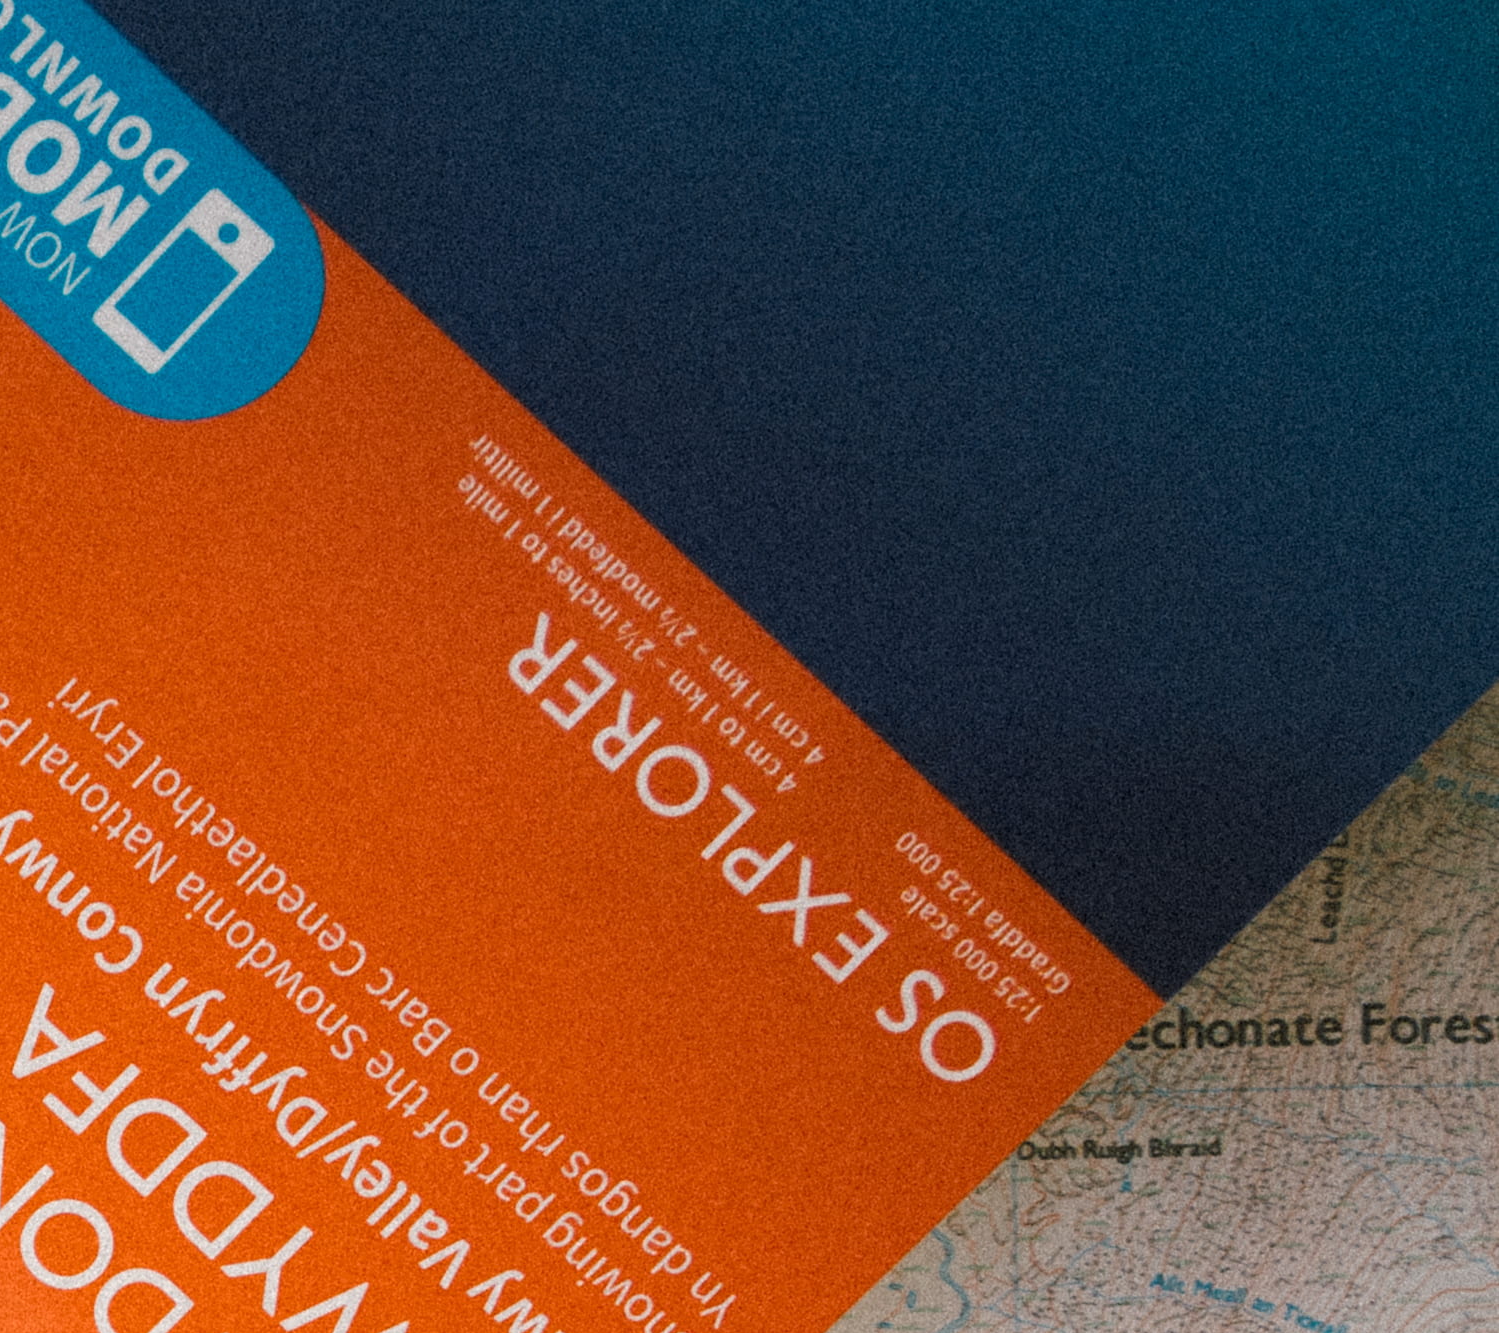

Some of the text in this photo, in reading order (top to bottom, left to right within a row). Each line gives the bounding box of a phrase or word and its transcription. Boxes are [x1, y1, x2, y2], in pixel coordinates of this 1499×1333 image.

[60, 759, 177, 881] National
[507, 611, 997, 1084] OS EXPLORER
[46, 677, 740, 1331] Yn dangos rhan o Barc Cenedlaethol Eryri
[175, 870, 369, 1056] Snowdonia
[143, 958, 471, 1291] Valley/Dyffryn
[363, 1048, 432, 1119] the
[411, 1111, 471, 1158] of
[482, 1147, 554, 1228] part
